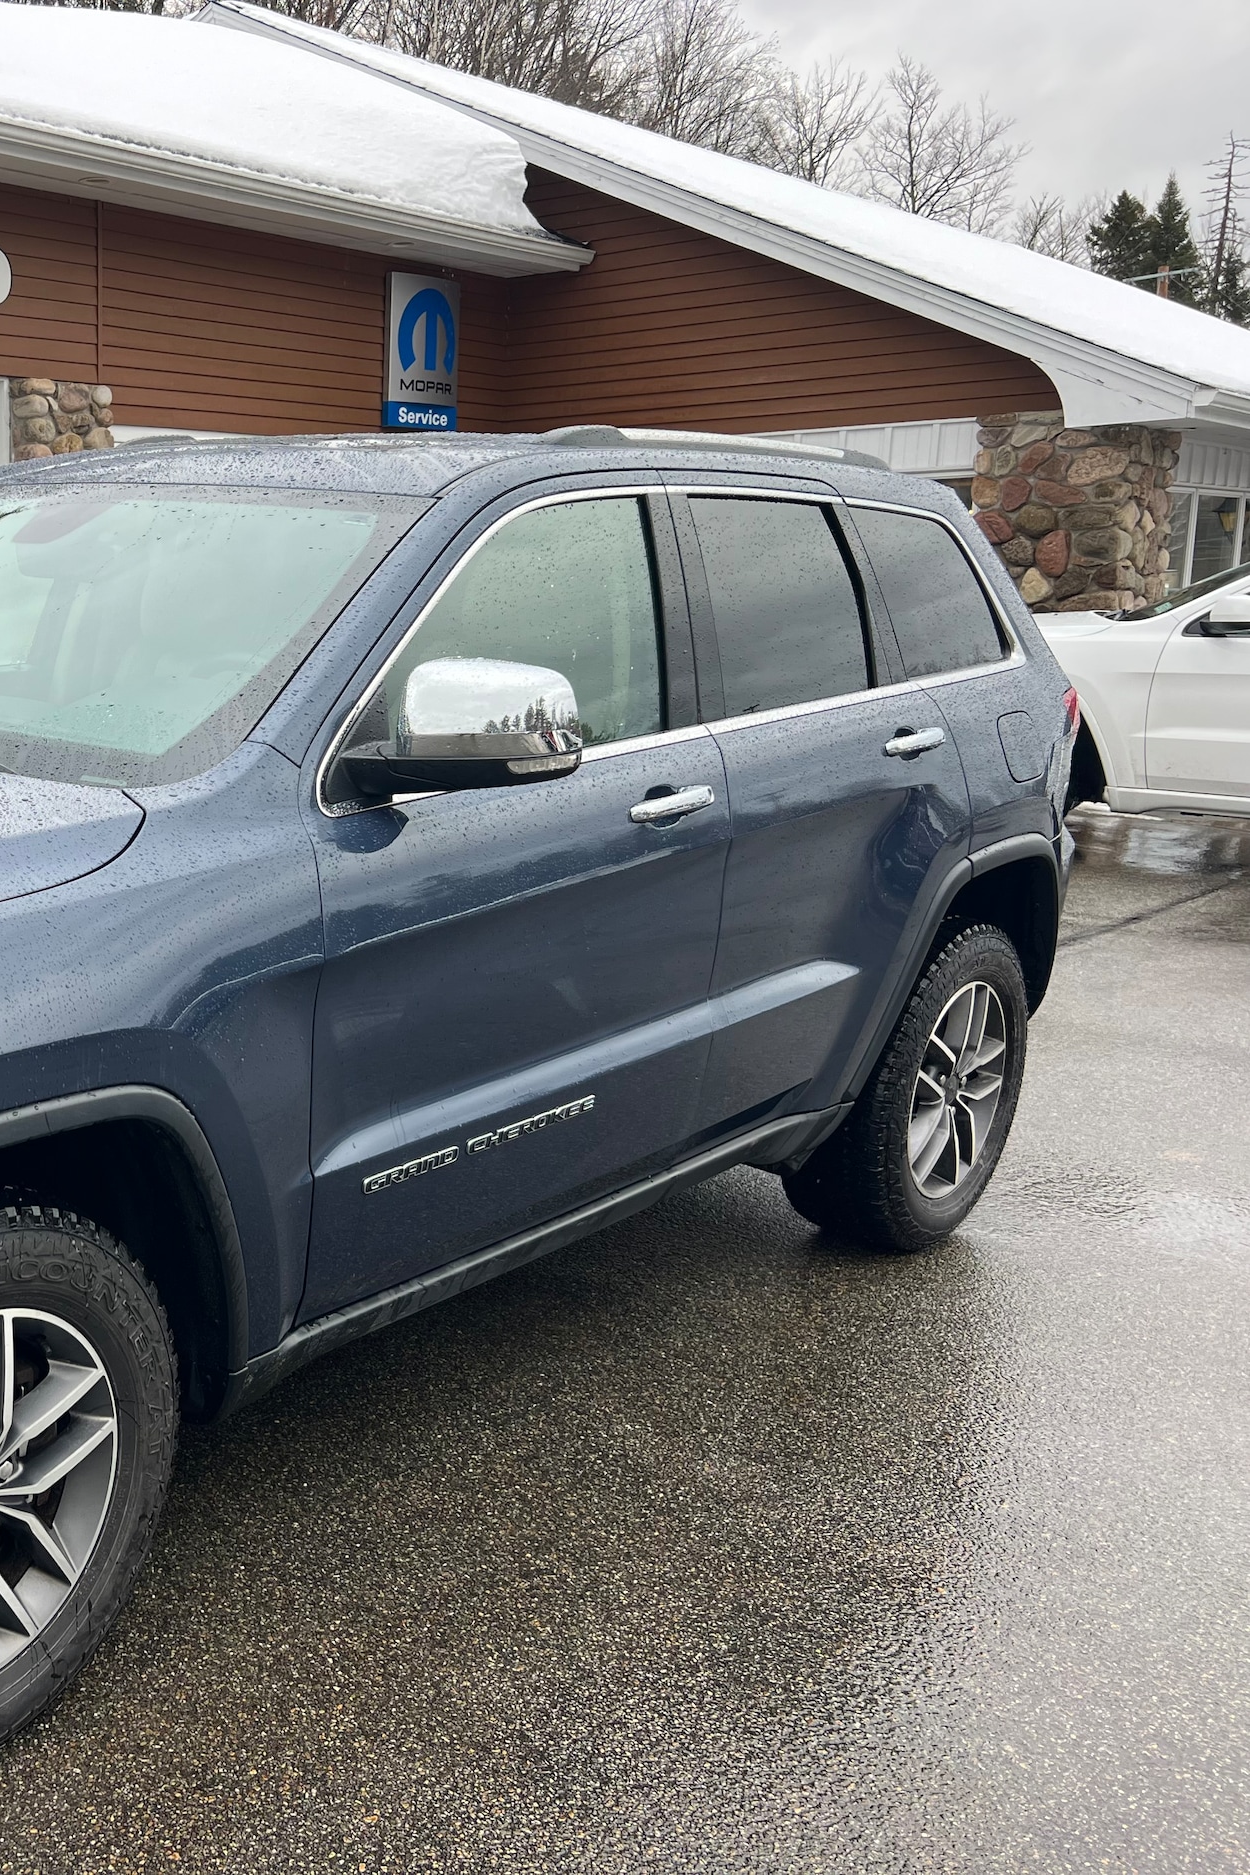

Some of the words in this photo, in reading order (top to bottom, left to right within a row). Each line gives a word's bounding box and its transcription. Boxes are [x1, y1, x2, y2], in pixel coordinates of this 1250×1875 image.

[399, 378, 452, 395] MOPAR
[398, 406, 448, 427] Service
[362, 1145, 459, 1195] GRAND
[466, 1094, 596, 1155] CHEROKEE
